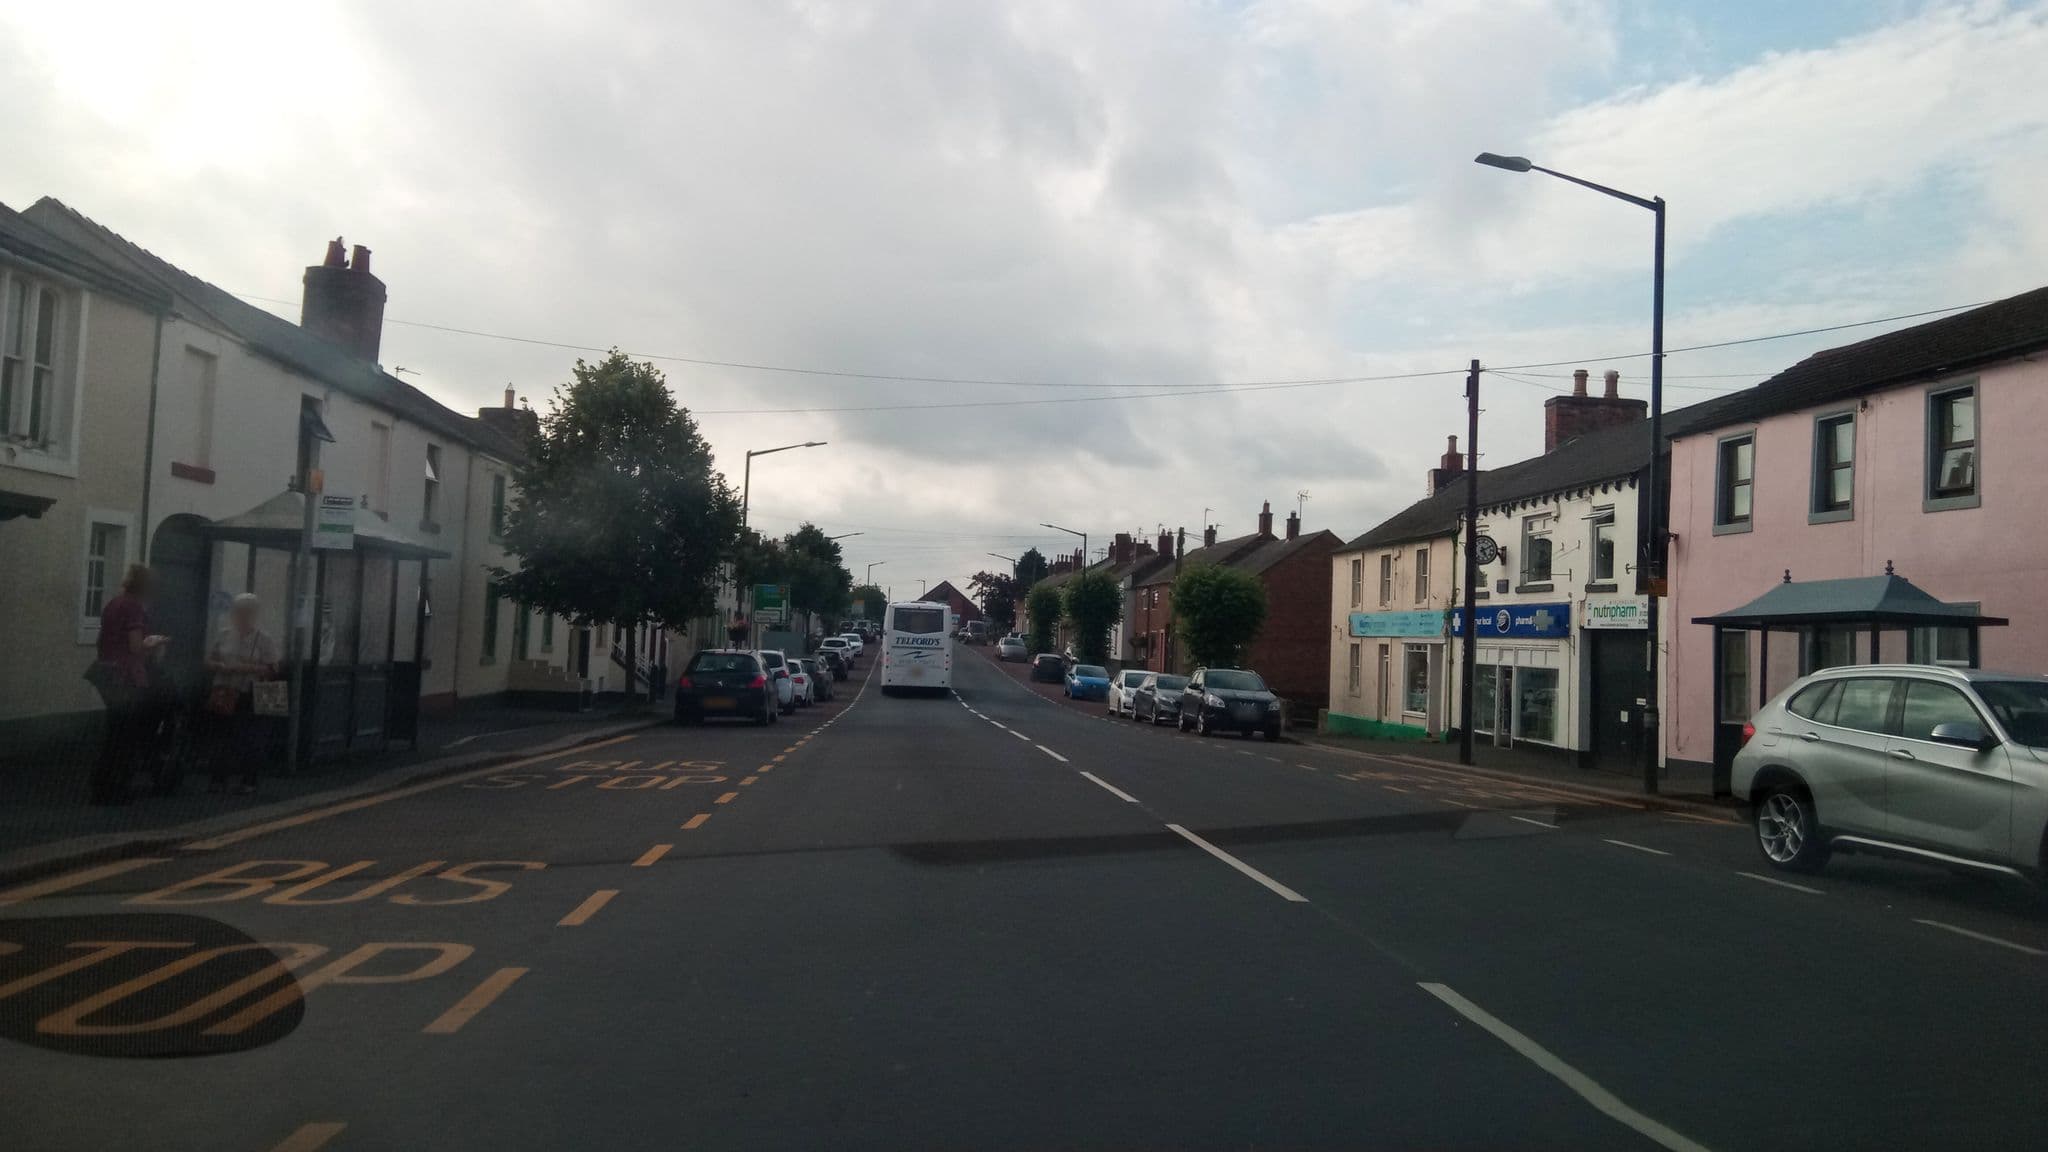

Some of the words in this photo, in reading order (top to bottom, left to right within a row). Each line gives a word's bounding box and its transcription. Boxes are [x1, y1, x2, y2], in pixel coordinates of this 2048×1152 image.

[1593, 604, 1637, 619] nutripharm
[895, 637, 941, 646] TELFORD'S
[551, 760, 727, 772] BUS
[463, 774, 729, 790] STOP
[119, 859, 550, 906] BUS
[0, 941, 476, 1036] TOP
